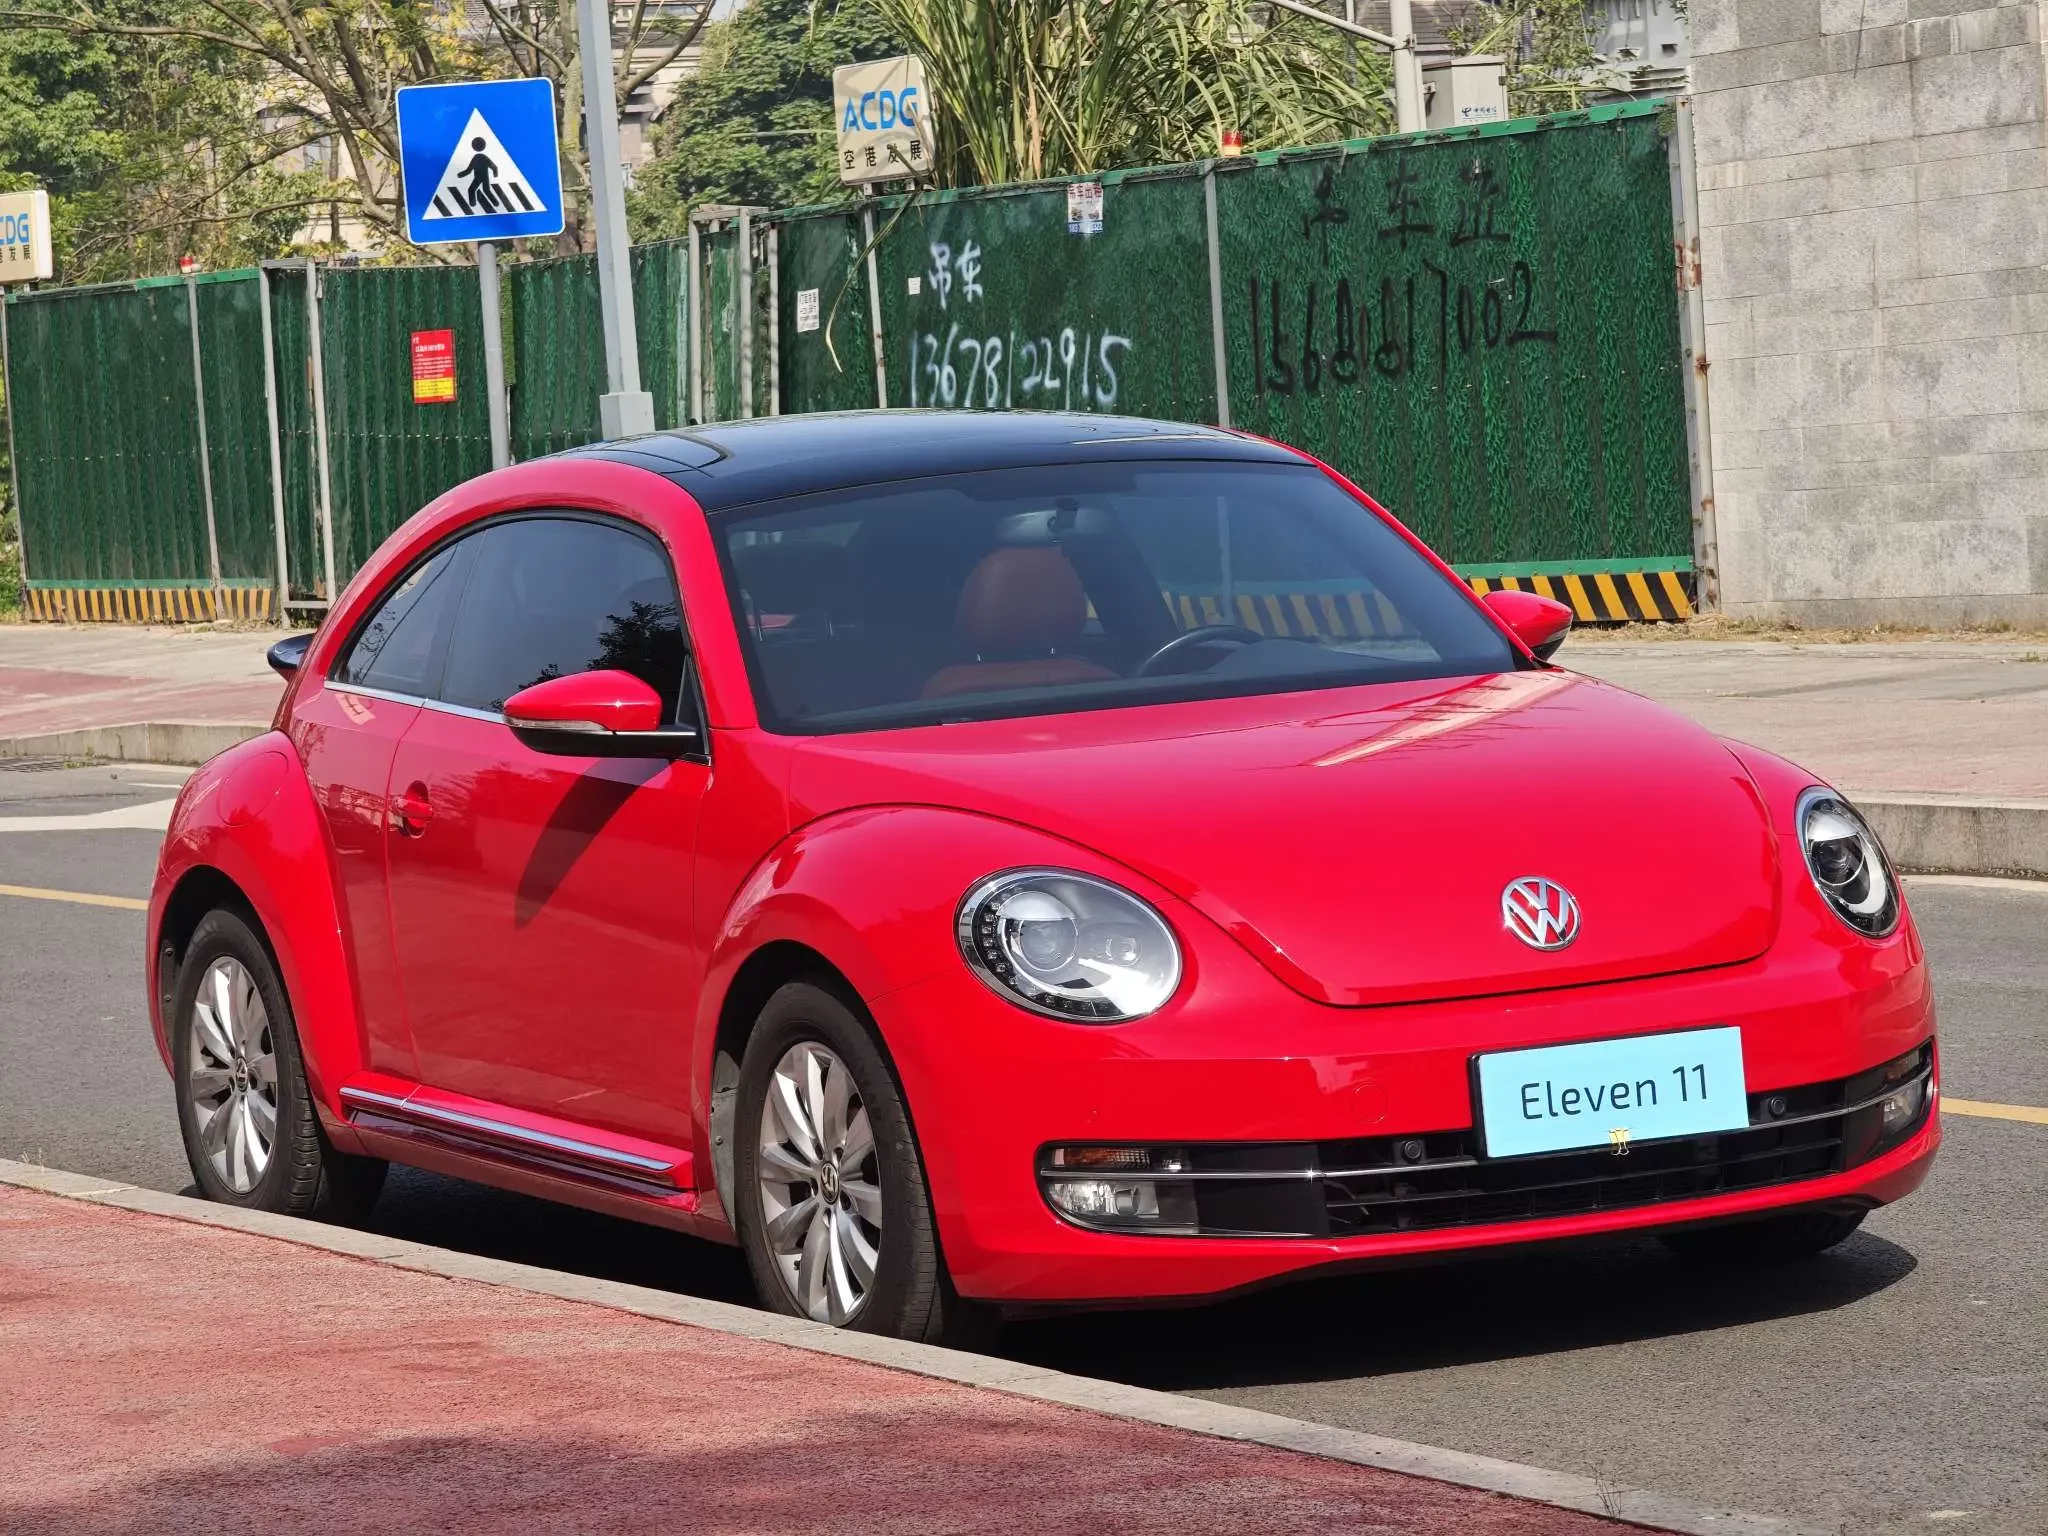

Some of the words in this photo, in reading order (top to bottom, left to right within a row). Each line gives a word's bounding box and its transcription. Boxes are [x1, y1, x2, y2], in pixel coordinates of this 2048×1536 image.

[842, 87, 919, 132] ACDG
[843, 139, 922, 170] 空港发展
[911, 321, 1132, 410] 13678122915
[1520, 1079, 1657, 1119] Eleven
[1672, 1063, 1707, 1102] 11
